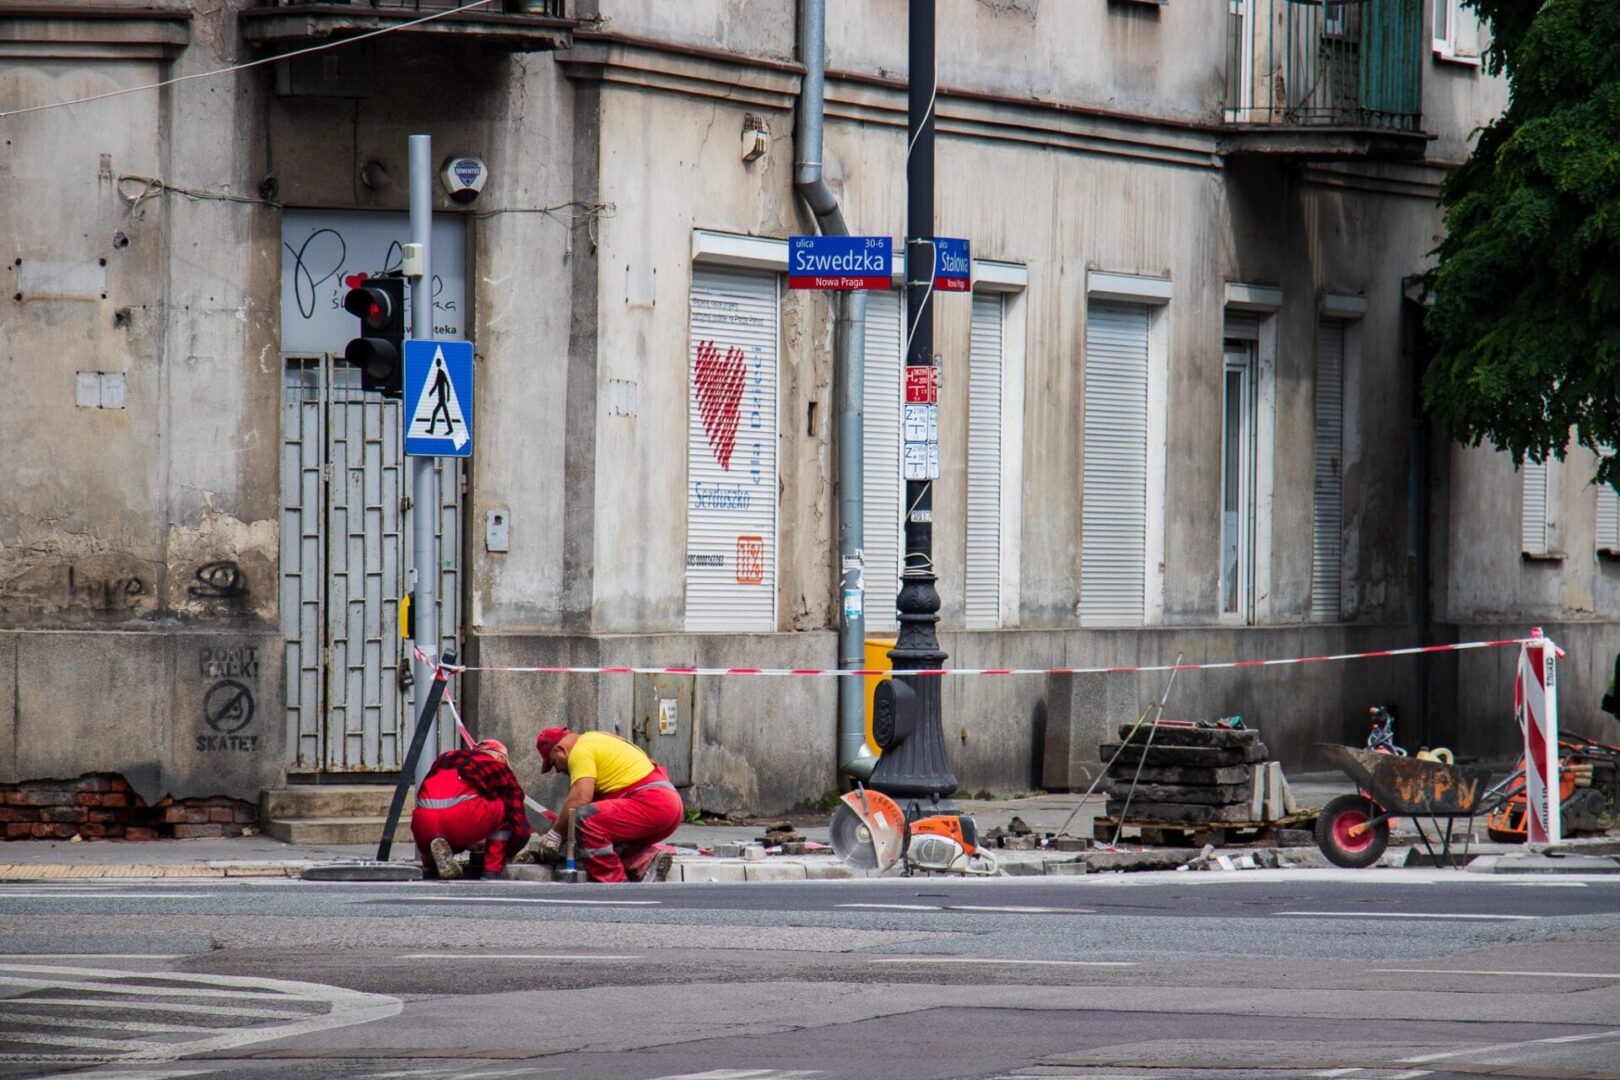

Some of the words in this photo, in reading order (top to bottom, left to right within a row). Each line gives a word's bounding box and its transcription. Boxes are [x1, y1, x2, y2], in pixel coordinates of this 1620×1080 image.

[796, 239, 814, 248] ulica
[865, 239, 884, 248] 30-6
[796, 250, 884, 271] Szwedzka
[942, 251, 968, 273] Stalowa
[816, 278, 839, 287] Nowa
[841, 278, 864, 288] Praga
[695, 482, 750, 508] Serduszko
[196, 736, 258, 752] SKATE!
